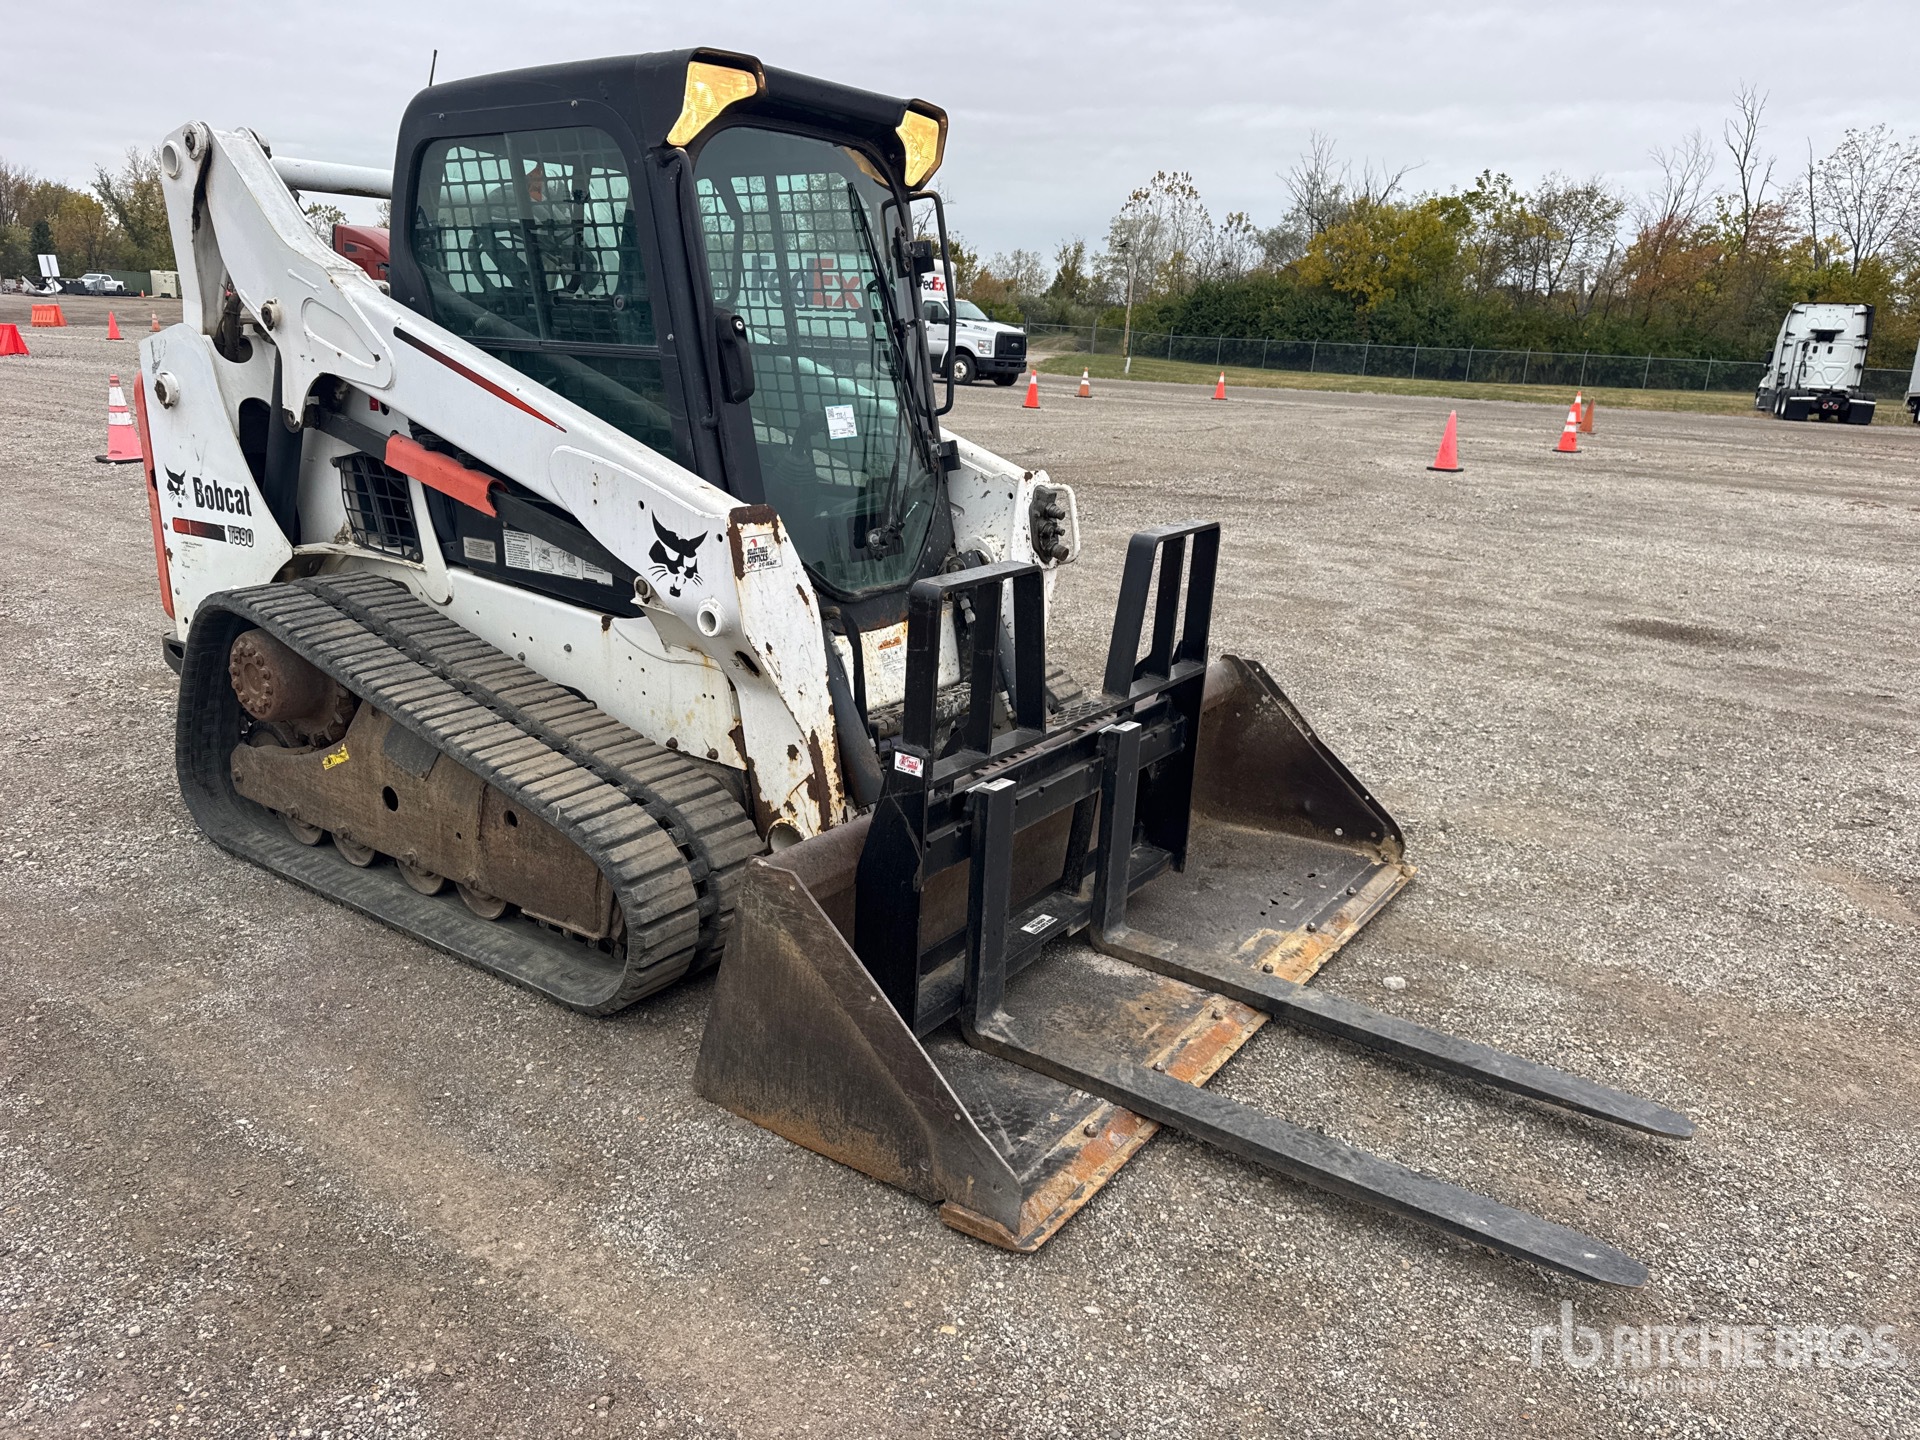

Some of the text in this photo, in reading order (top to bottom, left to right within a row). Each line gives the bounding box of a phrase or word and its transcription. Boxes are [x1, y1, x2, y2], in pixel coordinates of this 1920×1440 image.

[751, 257, 860, 309] FedEx
[922, 275, 945, 291] edEx
[192, 476, 252, 517] Bobcat
[227, 525, 254, 548] T590
